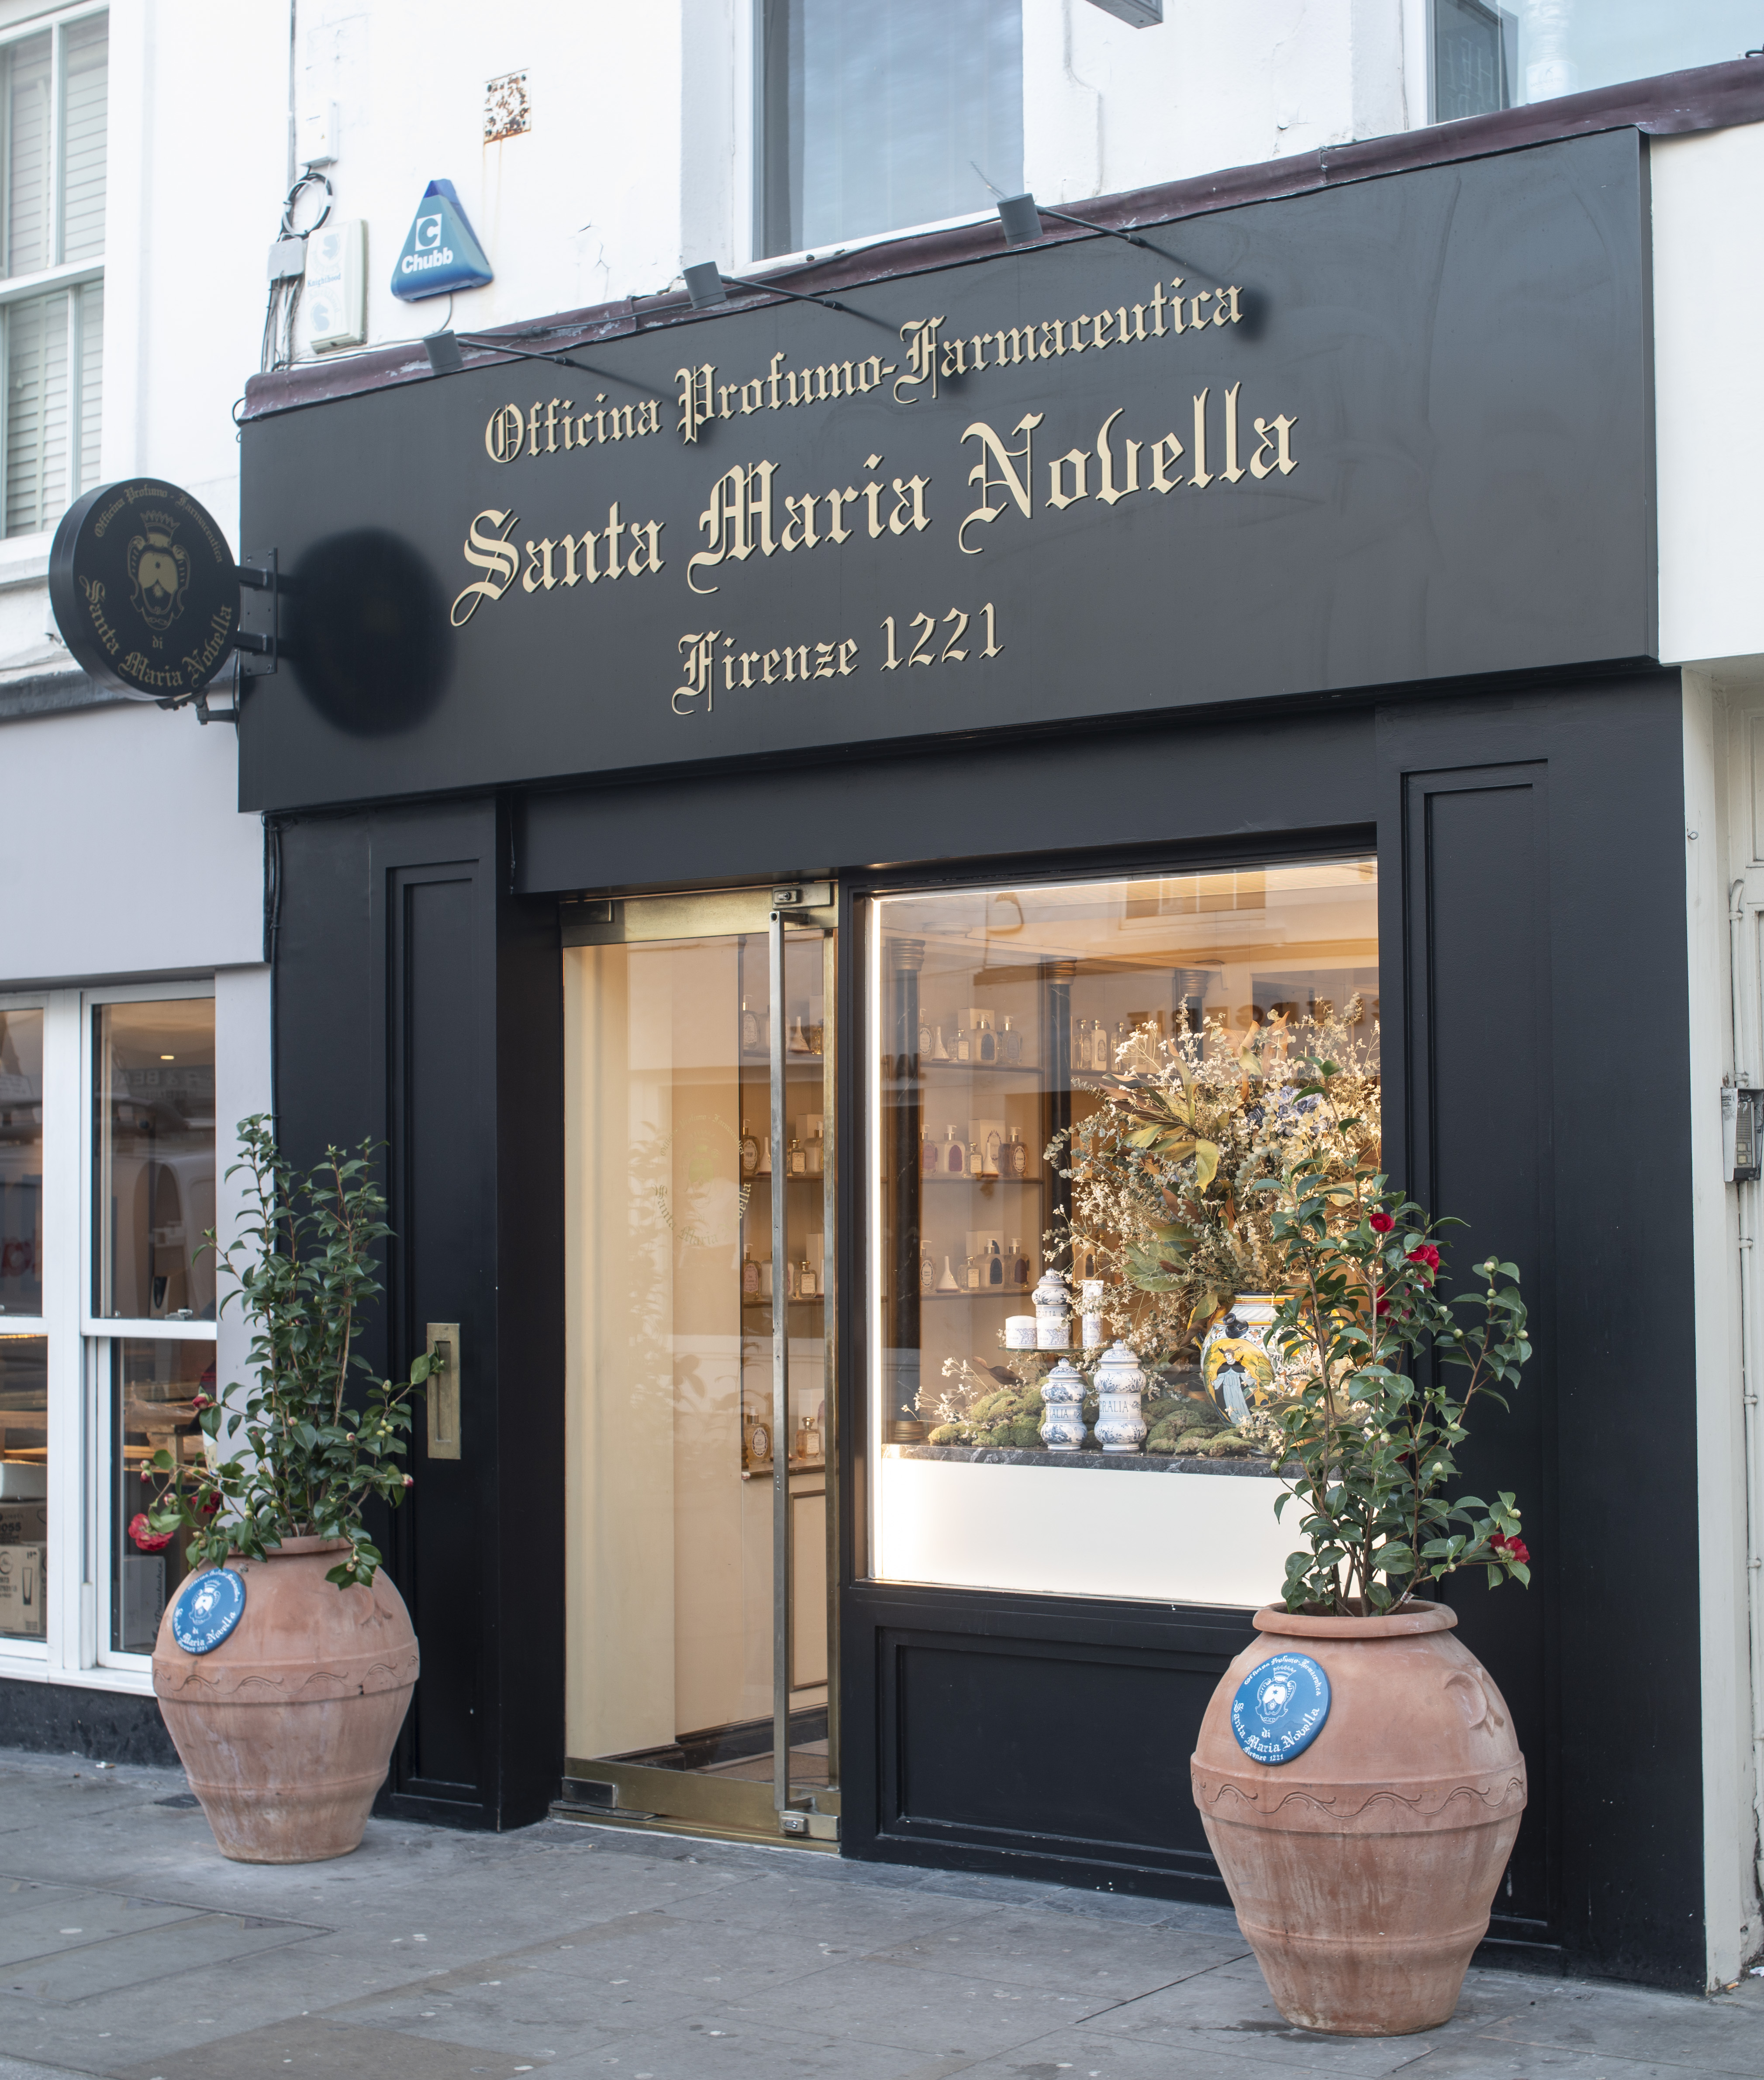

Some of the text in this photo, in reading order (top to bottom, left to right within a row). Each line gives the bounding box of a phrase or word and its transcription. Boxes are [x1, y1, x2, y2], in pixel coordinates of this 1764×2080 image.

[307, 273, 341, 287] Knighthood
[401, 247, 453, 274] Chubb
[484, 392, 662, 464] Officina
[94, 499, 125, 538] Officina
[124, 484, 168, 504] Profumo
[176, 492, 223, 563] Farmaceutica
[450, 381, 1298, 627] Santa Maria Novella
[79, 575, 232, 687] Santa Maria Novella
[152, 636, 163, 649] di
[671, 602, 1005, 715] Firenze 1221
[651, 1183, 677, 1230] Santa
[676, 1226, 718, 1246] Maria
[180, 1633, 205, 1647] Maria
[206, 1611, 236, 1645] Novella
[1244, 1662, 1270, 1685] Officina
[1233, 1700, 1320, 1753] Santa Maria Novella
[1261, 1727, 1271, 1738] di
[1243, 1746, 1267, 1762] Firenze
